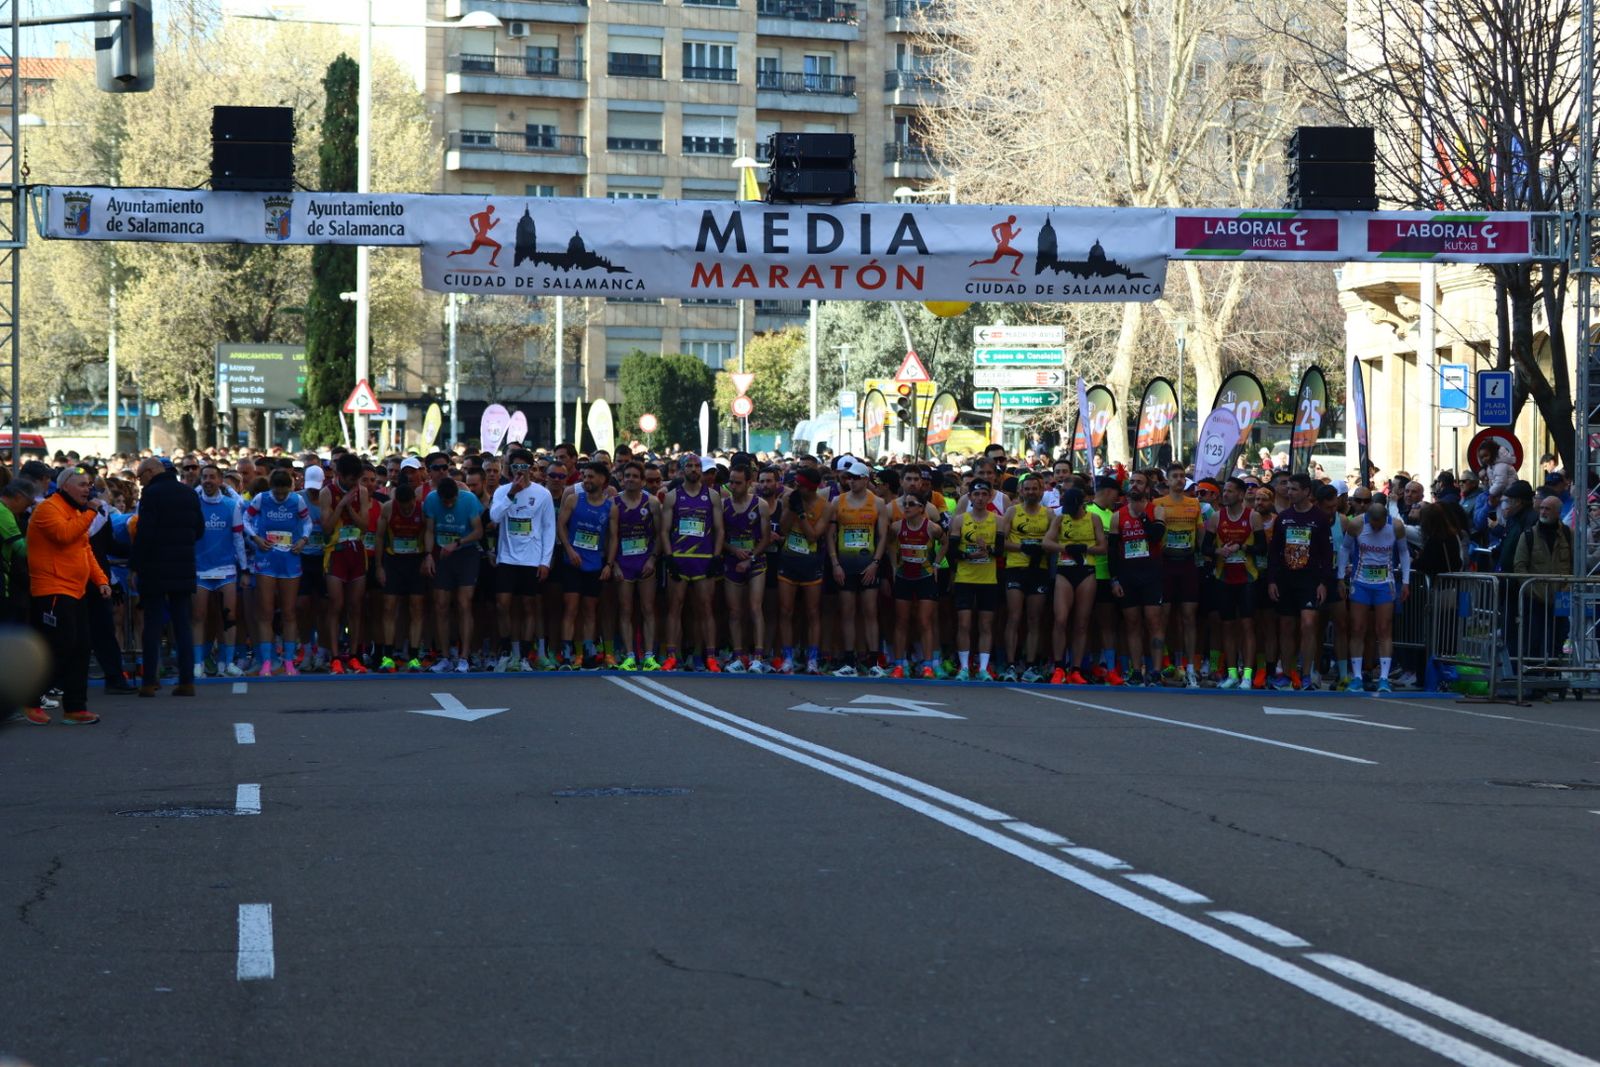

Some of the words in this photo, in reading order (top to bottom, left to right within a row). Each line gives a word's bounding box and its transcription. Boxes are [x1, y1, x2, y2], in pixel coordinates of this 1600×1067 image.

[106, 197, 204, 216] Ayuntamiento
[307, 200, 404, 219] Ayuntamiento
[106, 217, 123, 232] de
[127, 217, 205, 234] Salamanca
[307, 220, 324, 236] de
[328, 220, 405, 236] Salamanca
[695, 209, 929, 255] MEDIA
[1204, 220, 1286, 236] LABORAL
[1396, 223, 1477, 239] LABORAL
[1252, 237, 1287, 248] kutxa
[1444, 240, 1478, 251] kutxa
[443, 274, 506, 288] CIUDAD
[515, 276, 534, 289] DE
[543, 277, 646, 291] SALAMANCA
[690, 259, 925, 291] MARATÓN
[965, 282, 1027, 295] CIUDAD
[1035, 284, 1054, 295] DE
[1062, 282, 1162, 296] SALAMANCA
[205, 520, 226, 529] ebra
